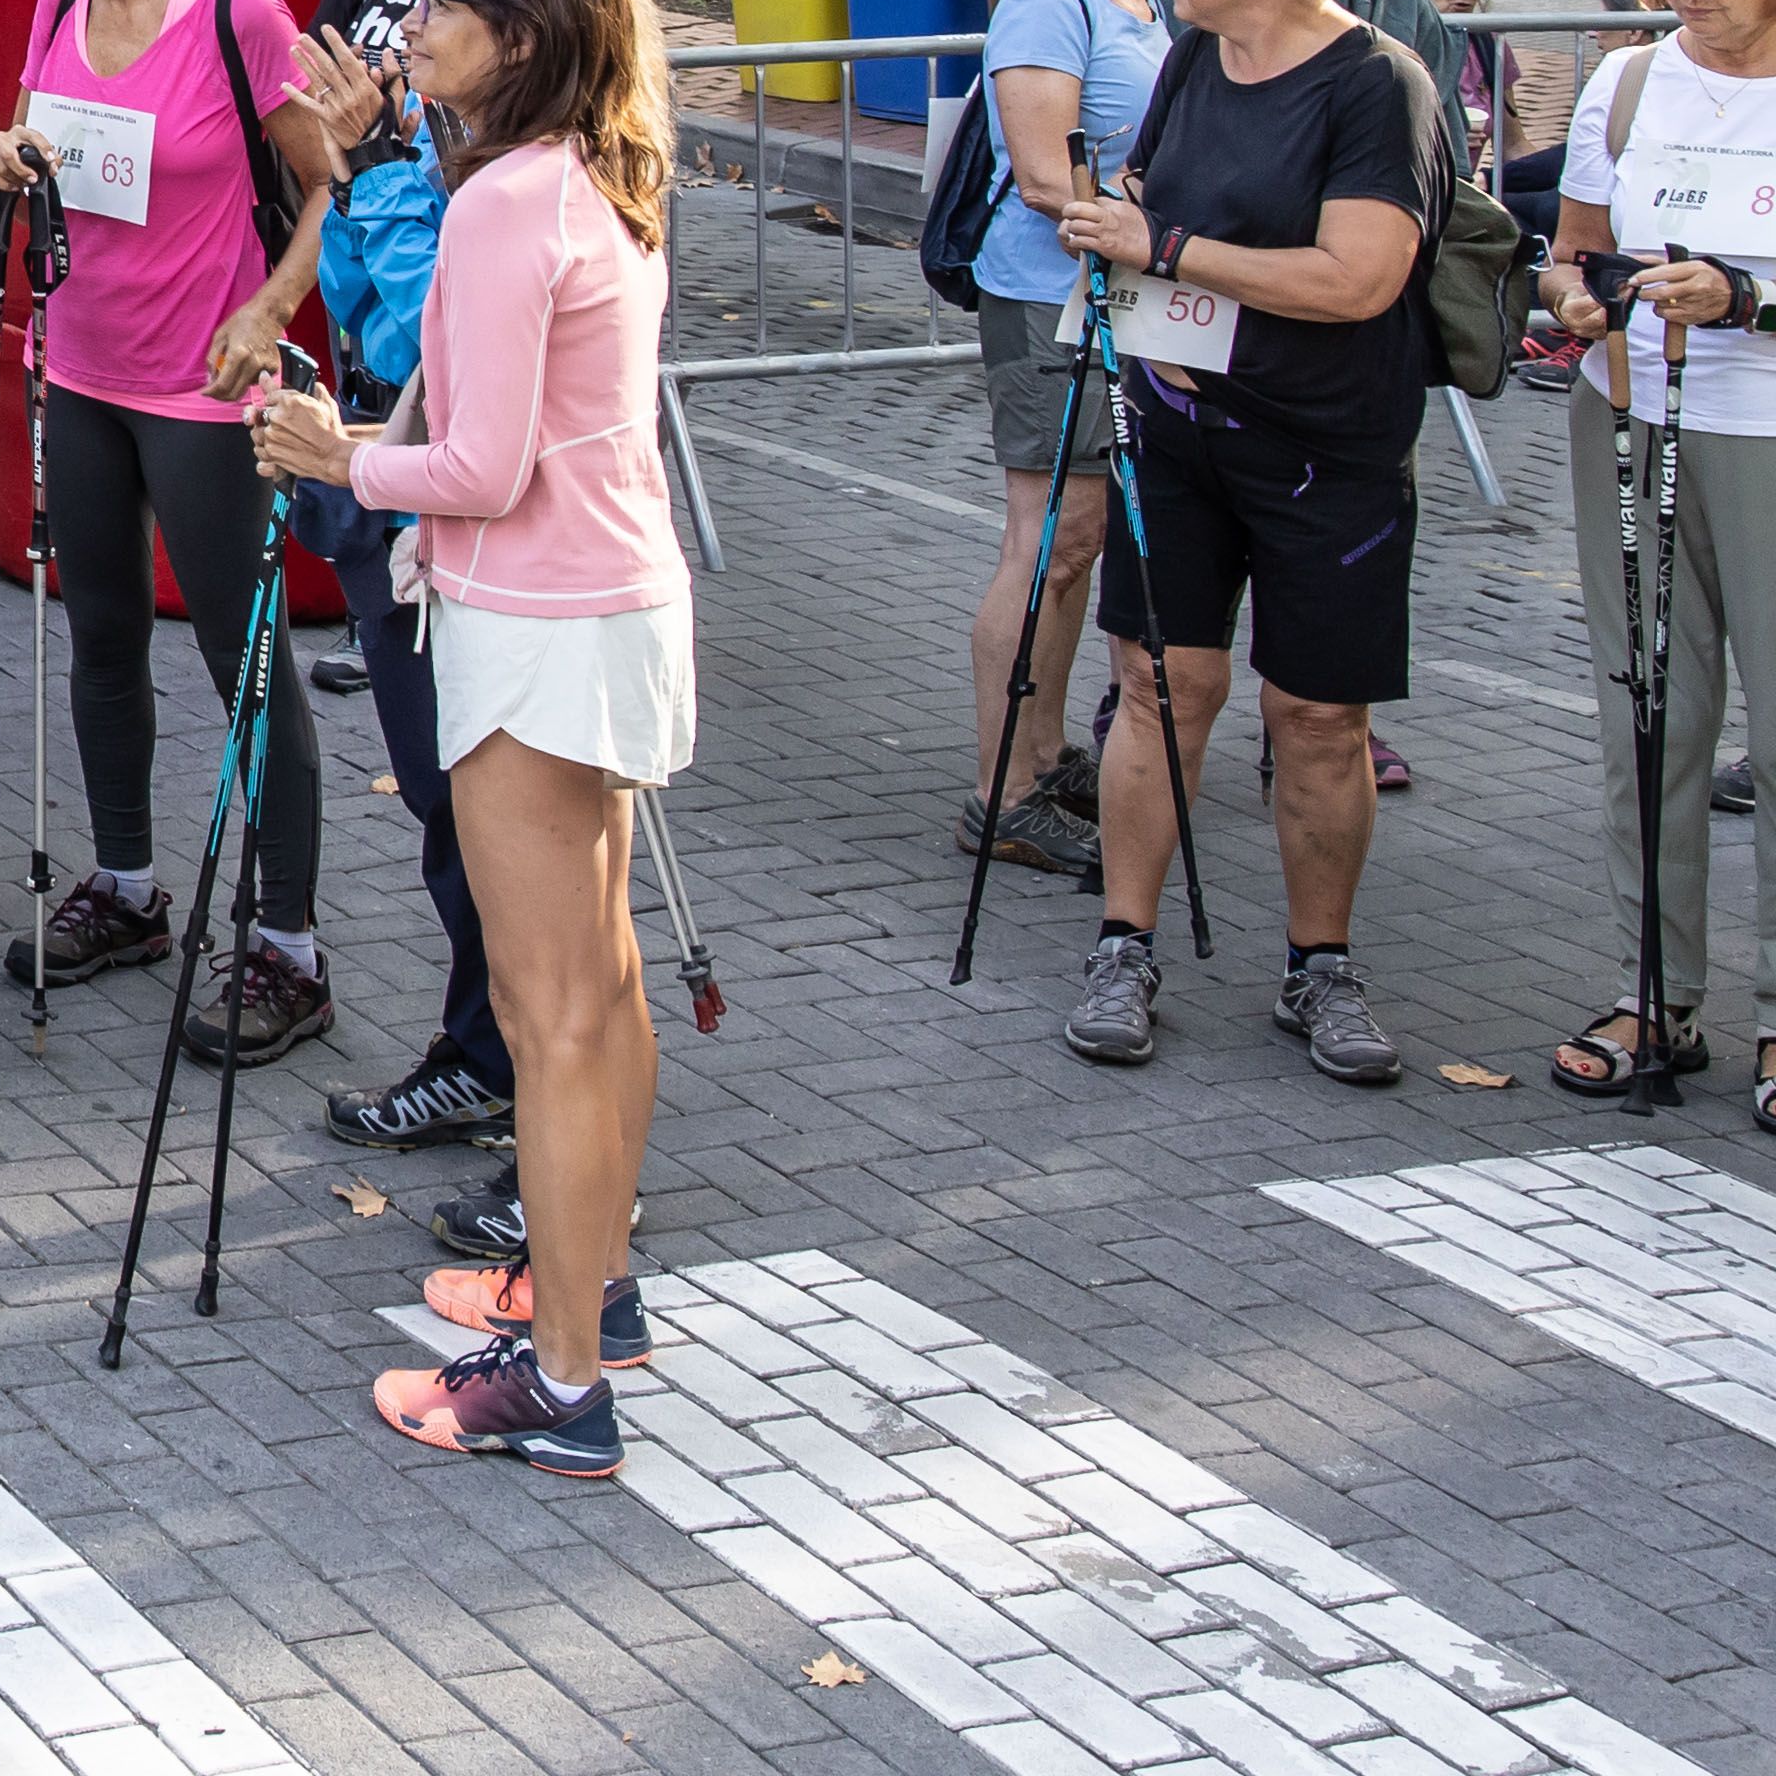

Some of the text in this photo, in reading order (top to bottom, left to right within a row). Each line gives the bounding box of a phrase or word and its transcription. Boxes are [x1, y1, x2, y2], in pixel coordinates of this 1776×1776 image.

[68, 147, 85, 164] 6.6
[101, 152, 135, 188] 63
[1663, 143, 1692, 153] CURSA
[1706, 146, 1718, 155] DE
[1719, 147, 1774, 158] BELLATERRA
[1668, 188, 1684, 203] La
[1685, 188, 1709, 205] 6.6
[54, 233, 68, 276] LEKI
[1119, 288, 1140, 306] 6.6
[1166, 289, 1216, 327] 50
[1108, 382, 1131, 444] iwalk
[1659, 441, 1678, 515] iwalk
[1618, 482, 1638, 552] iwalk
